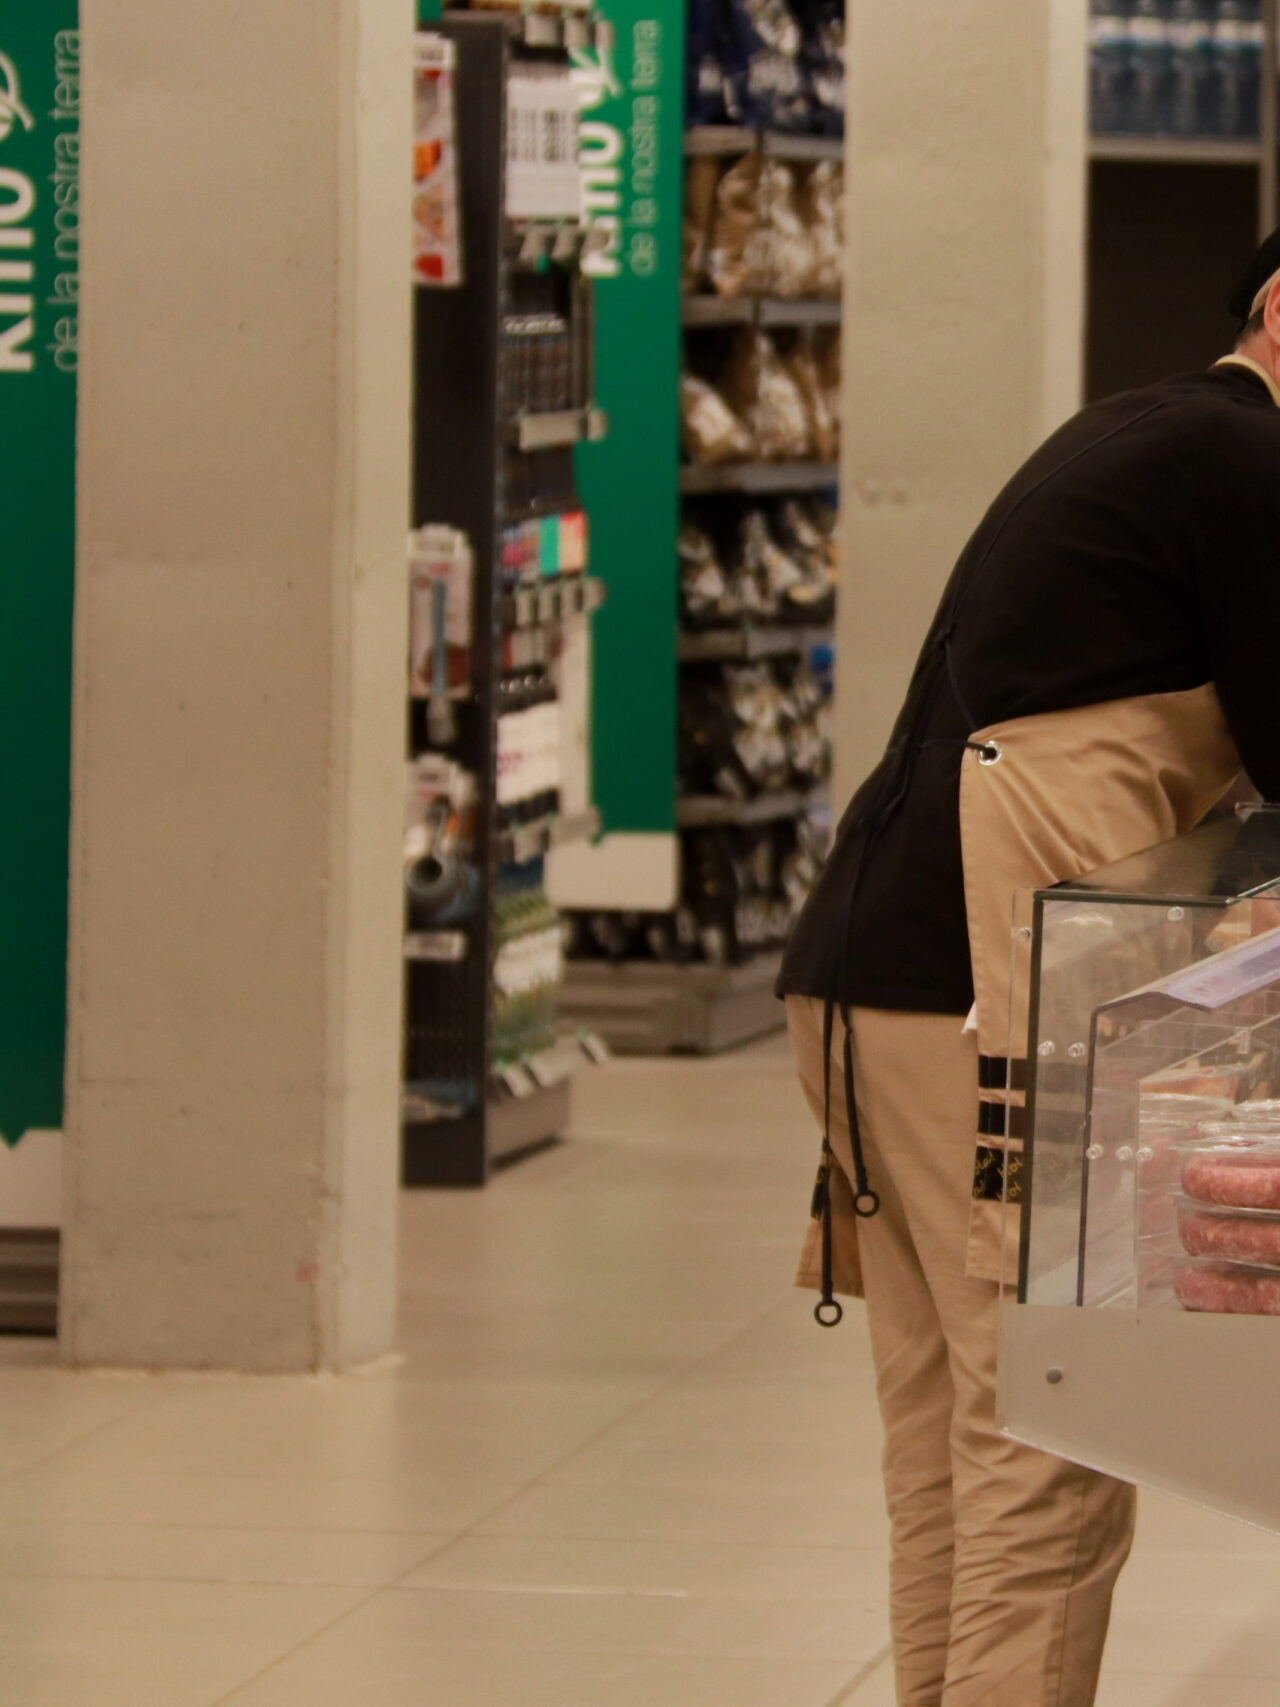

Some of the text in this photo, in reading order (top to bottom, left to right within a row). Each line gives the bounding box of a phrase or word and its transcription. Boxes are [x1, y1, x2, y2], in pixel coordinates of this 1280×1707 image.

[630, 19, 659, 91] terra
[630, 95, 658, 194] nostra
[46, 29, 79, 374] de la nostra terra
